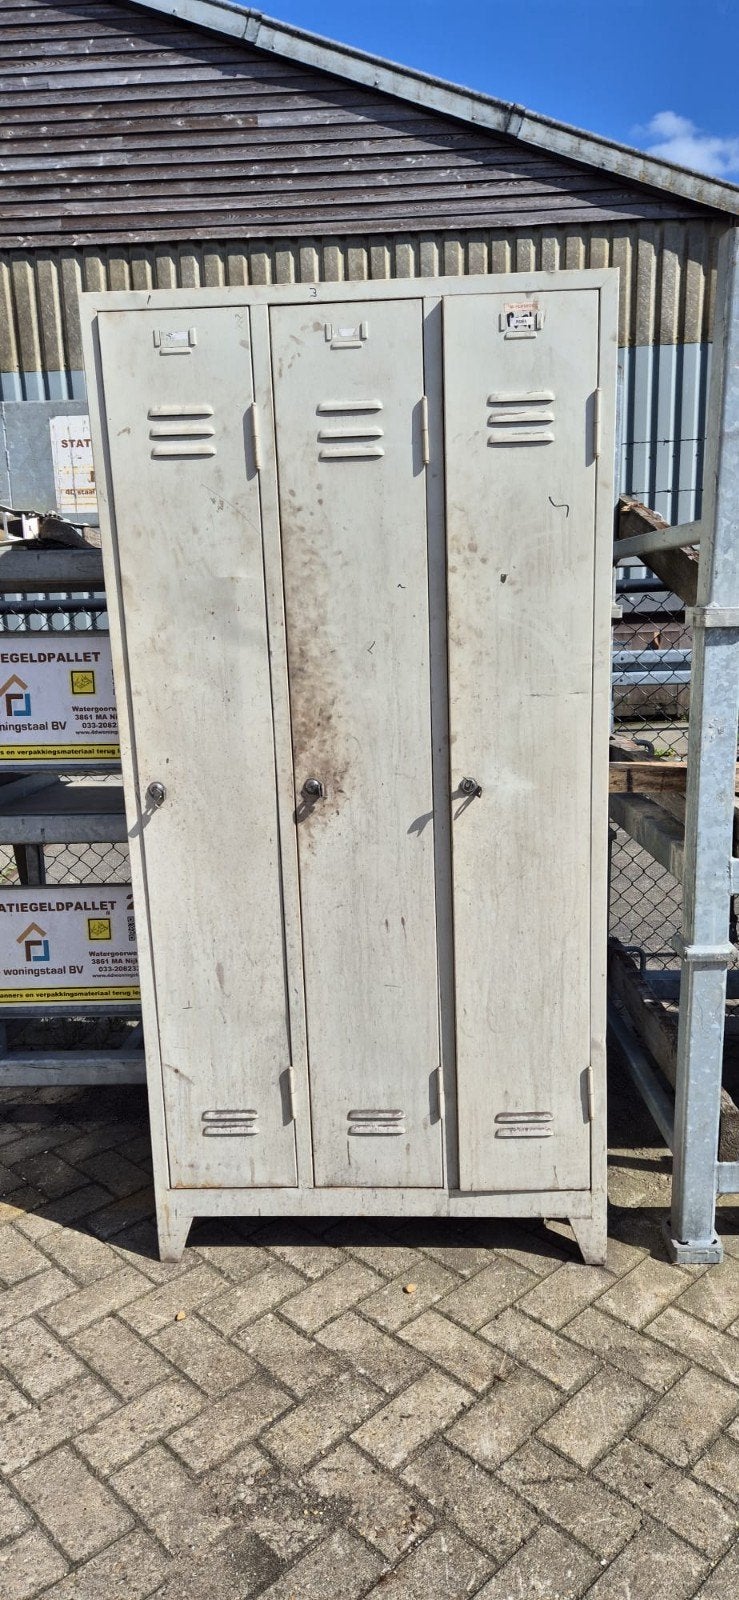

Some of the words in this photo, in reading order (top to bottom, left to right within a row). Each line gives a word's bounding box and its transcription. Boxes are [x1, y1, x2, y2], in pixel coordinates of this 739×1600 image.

[61, 438, 91, 448] STAT
[51, 721, 67, 730] BV
[3, 966, 66, 977] woningstaal
[69, 965, 84, 974] BV
